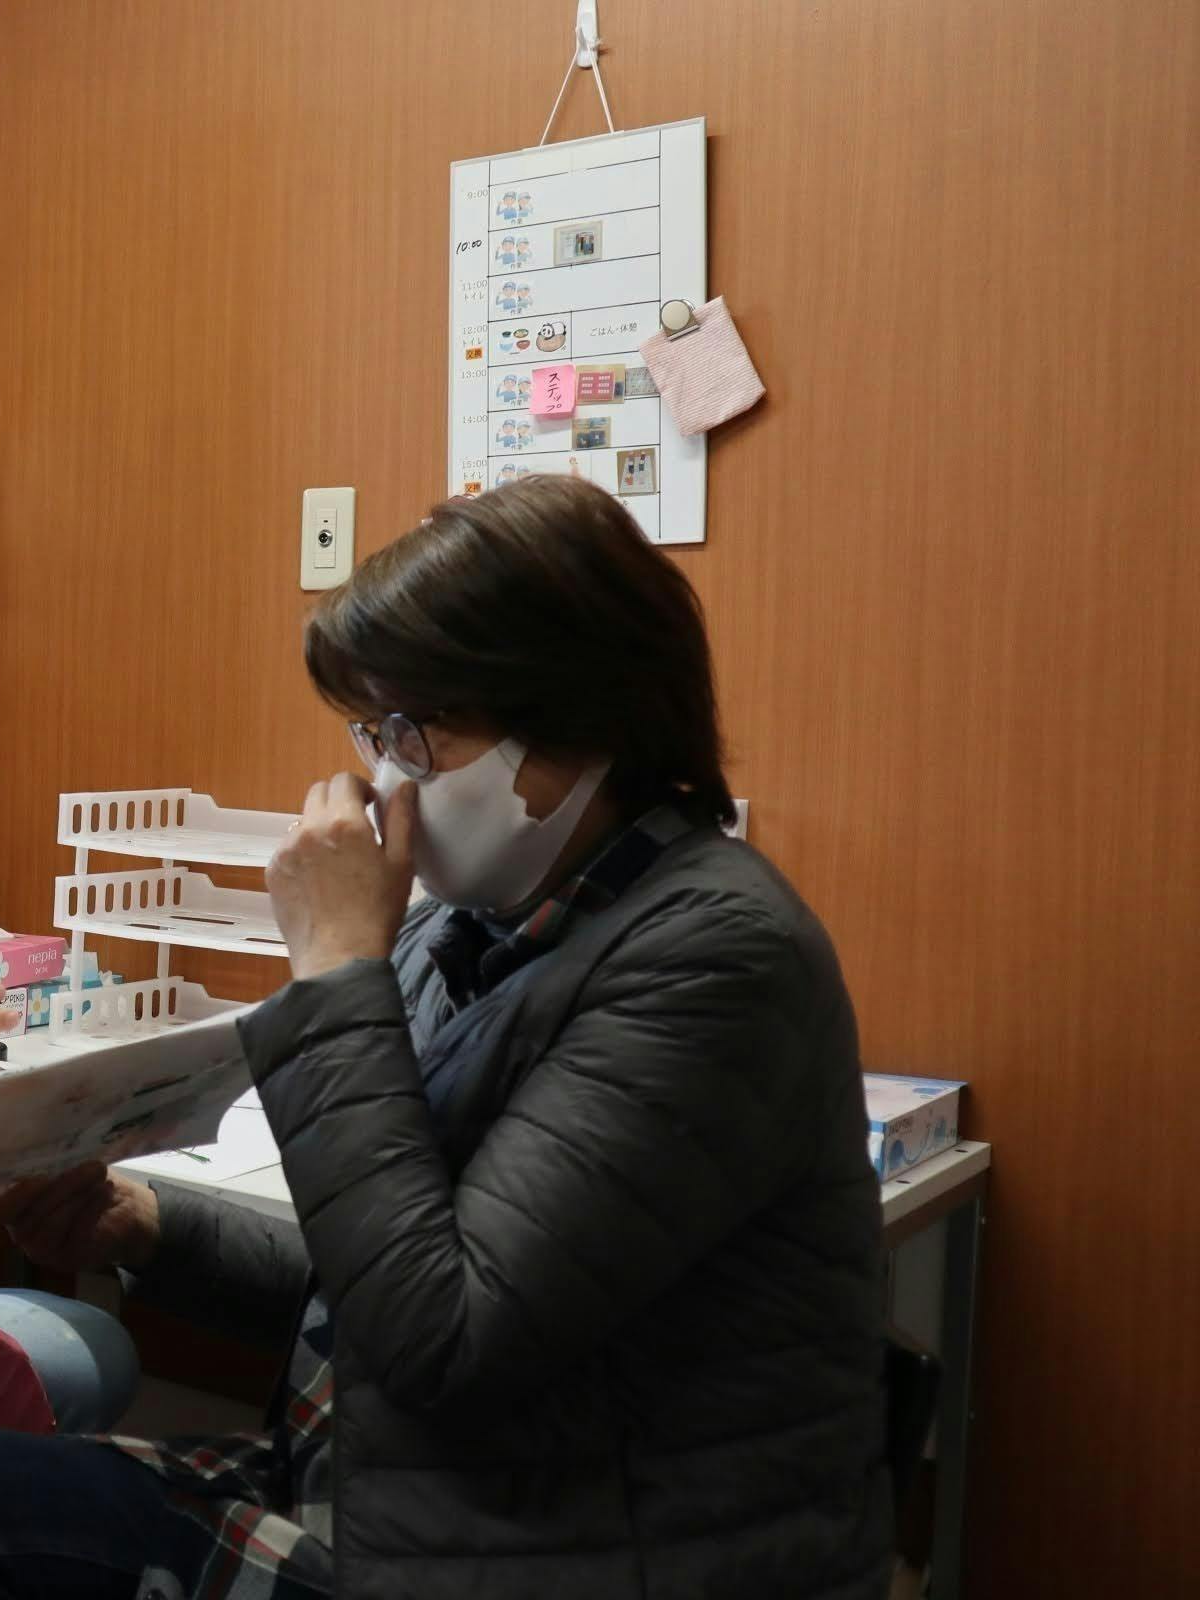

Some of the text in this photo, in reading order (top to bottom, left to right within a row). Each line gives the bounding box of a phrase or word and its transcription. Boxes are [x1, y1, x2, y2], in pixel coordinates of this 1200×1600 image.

[466, 189, 488, 200] 9:00
[462, 280, 488, 290] 11:00
[462, 325, 488, 335] 12:00
[545, 372, 563, 413] ステップ
[462, 415, 488, 424] 14:00
[28, 947, 57, 965] nepia
